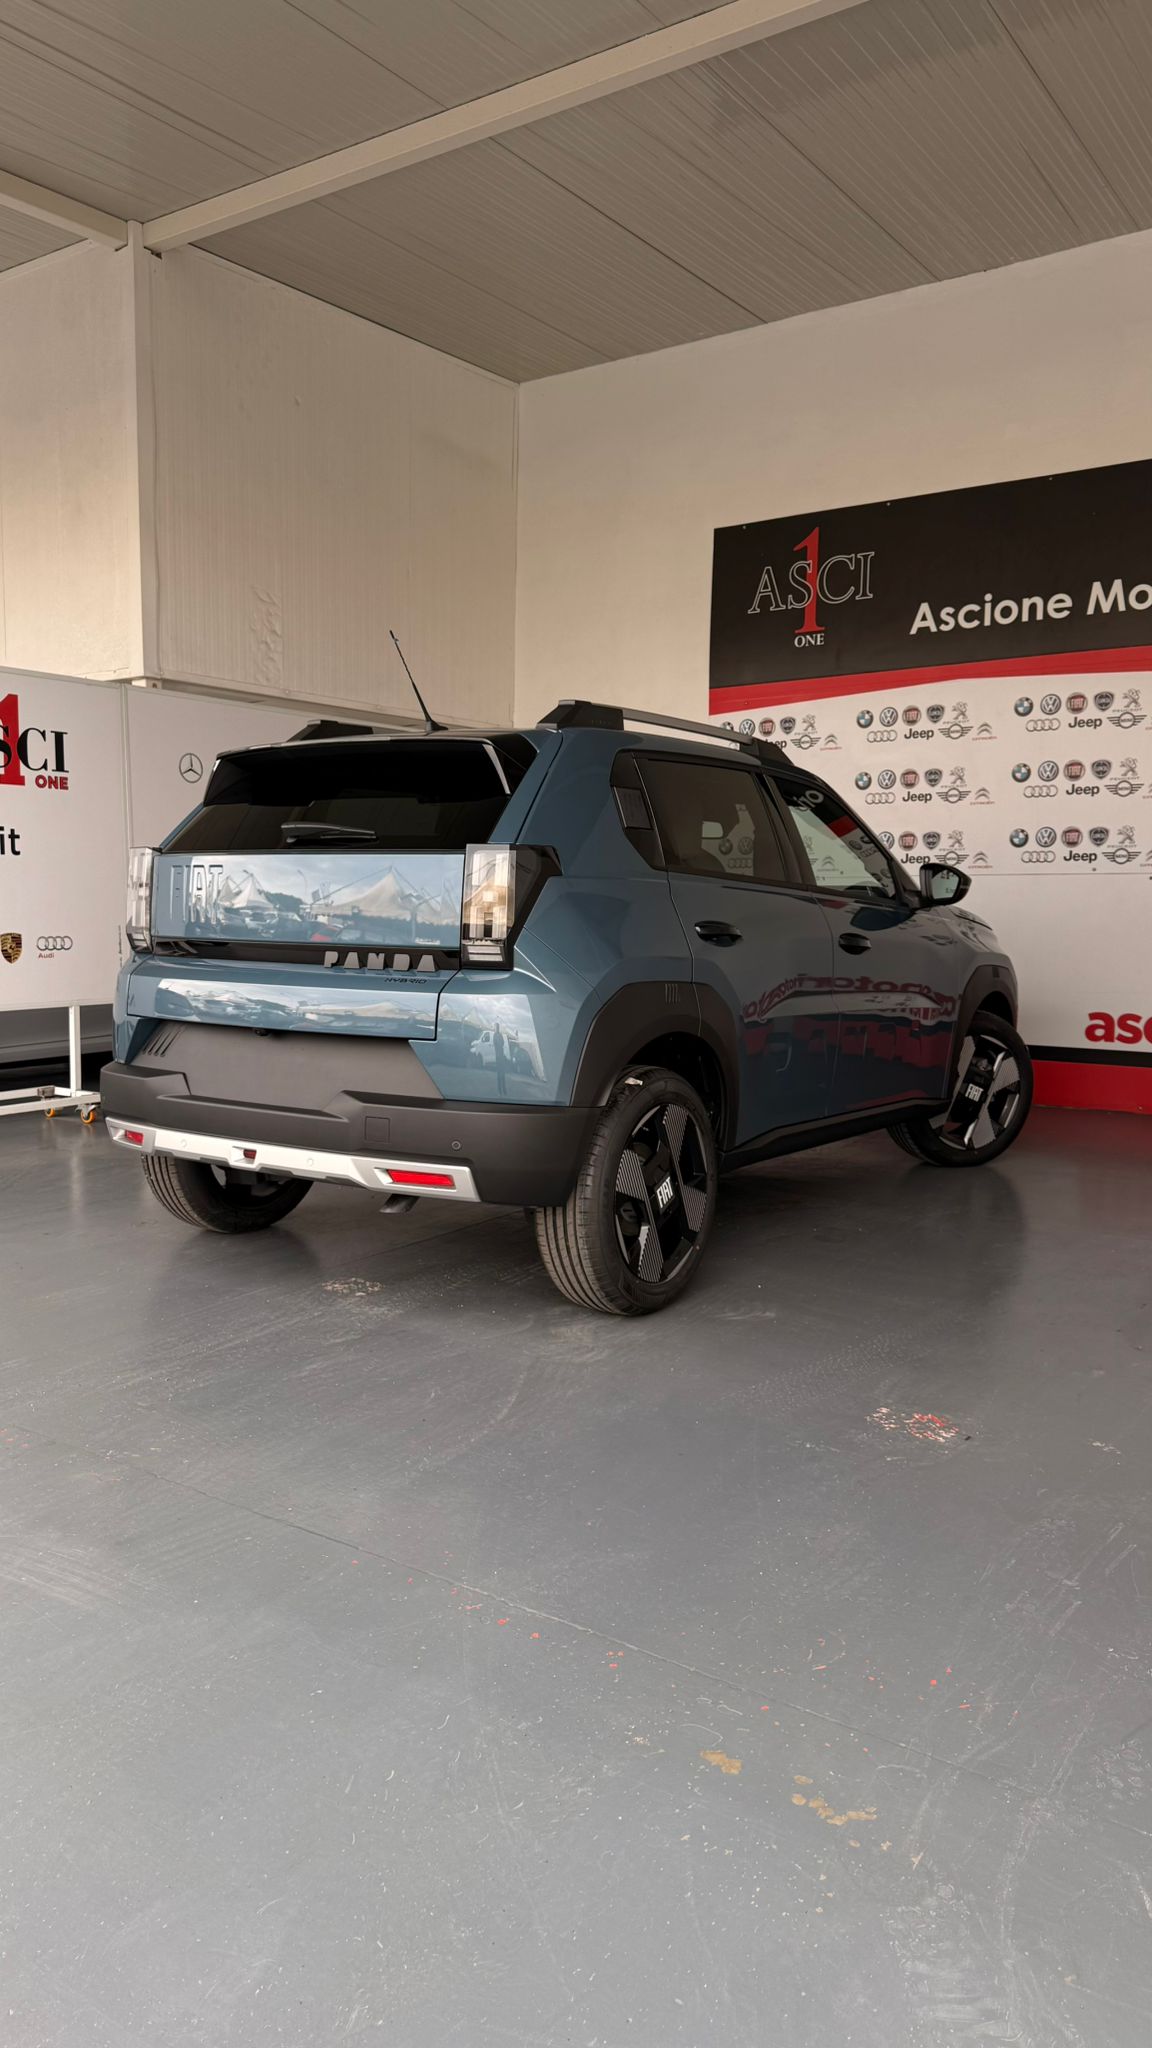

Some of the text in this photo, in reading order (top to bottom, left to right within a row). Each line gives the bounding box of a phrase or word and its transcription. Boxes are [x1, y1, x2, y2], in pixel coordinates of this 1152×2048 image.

[909, 593, 1073, 635] Ascione
[794, 633, 824, 648] ONE
[1068, 716, 1102, 729] Jeep
[904, 728, 934, 740] Jeep
[35, 775, 69, 790] ONE
[902, 791, 933, 803] Jeep
[1065, 784, 1100, 797] Jeep
[900, 853, 930, 864] Jeep
[1063, 850, 1098, 863] Jeep
[170, 864, 224, 925] FIAT
[323, 951, 436, 973] PANDA
[964, 1083, 984, 1102] FIAT
[656, 1176, 673, 1208] FIAT
